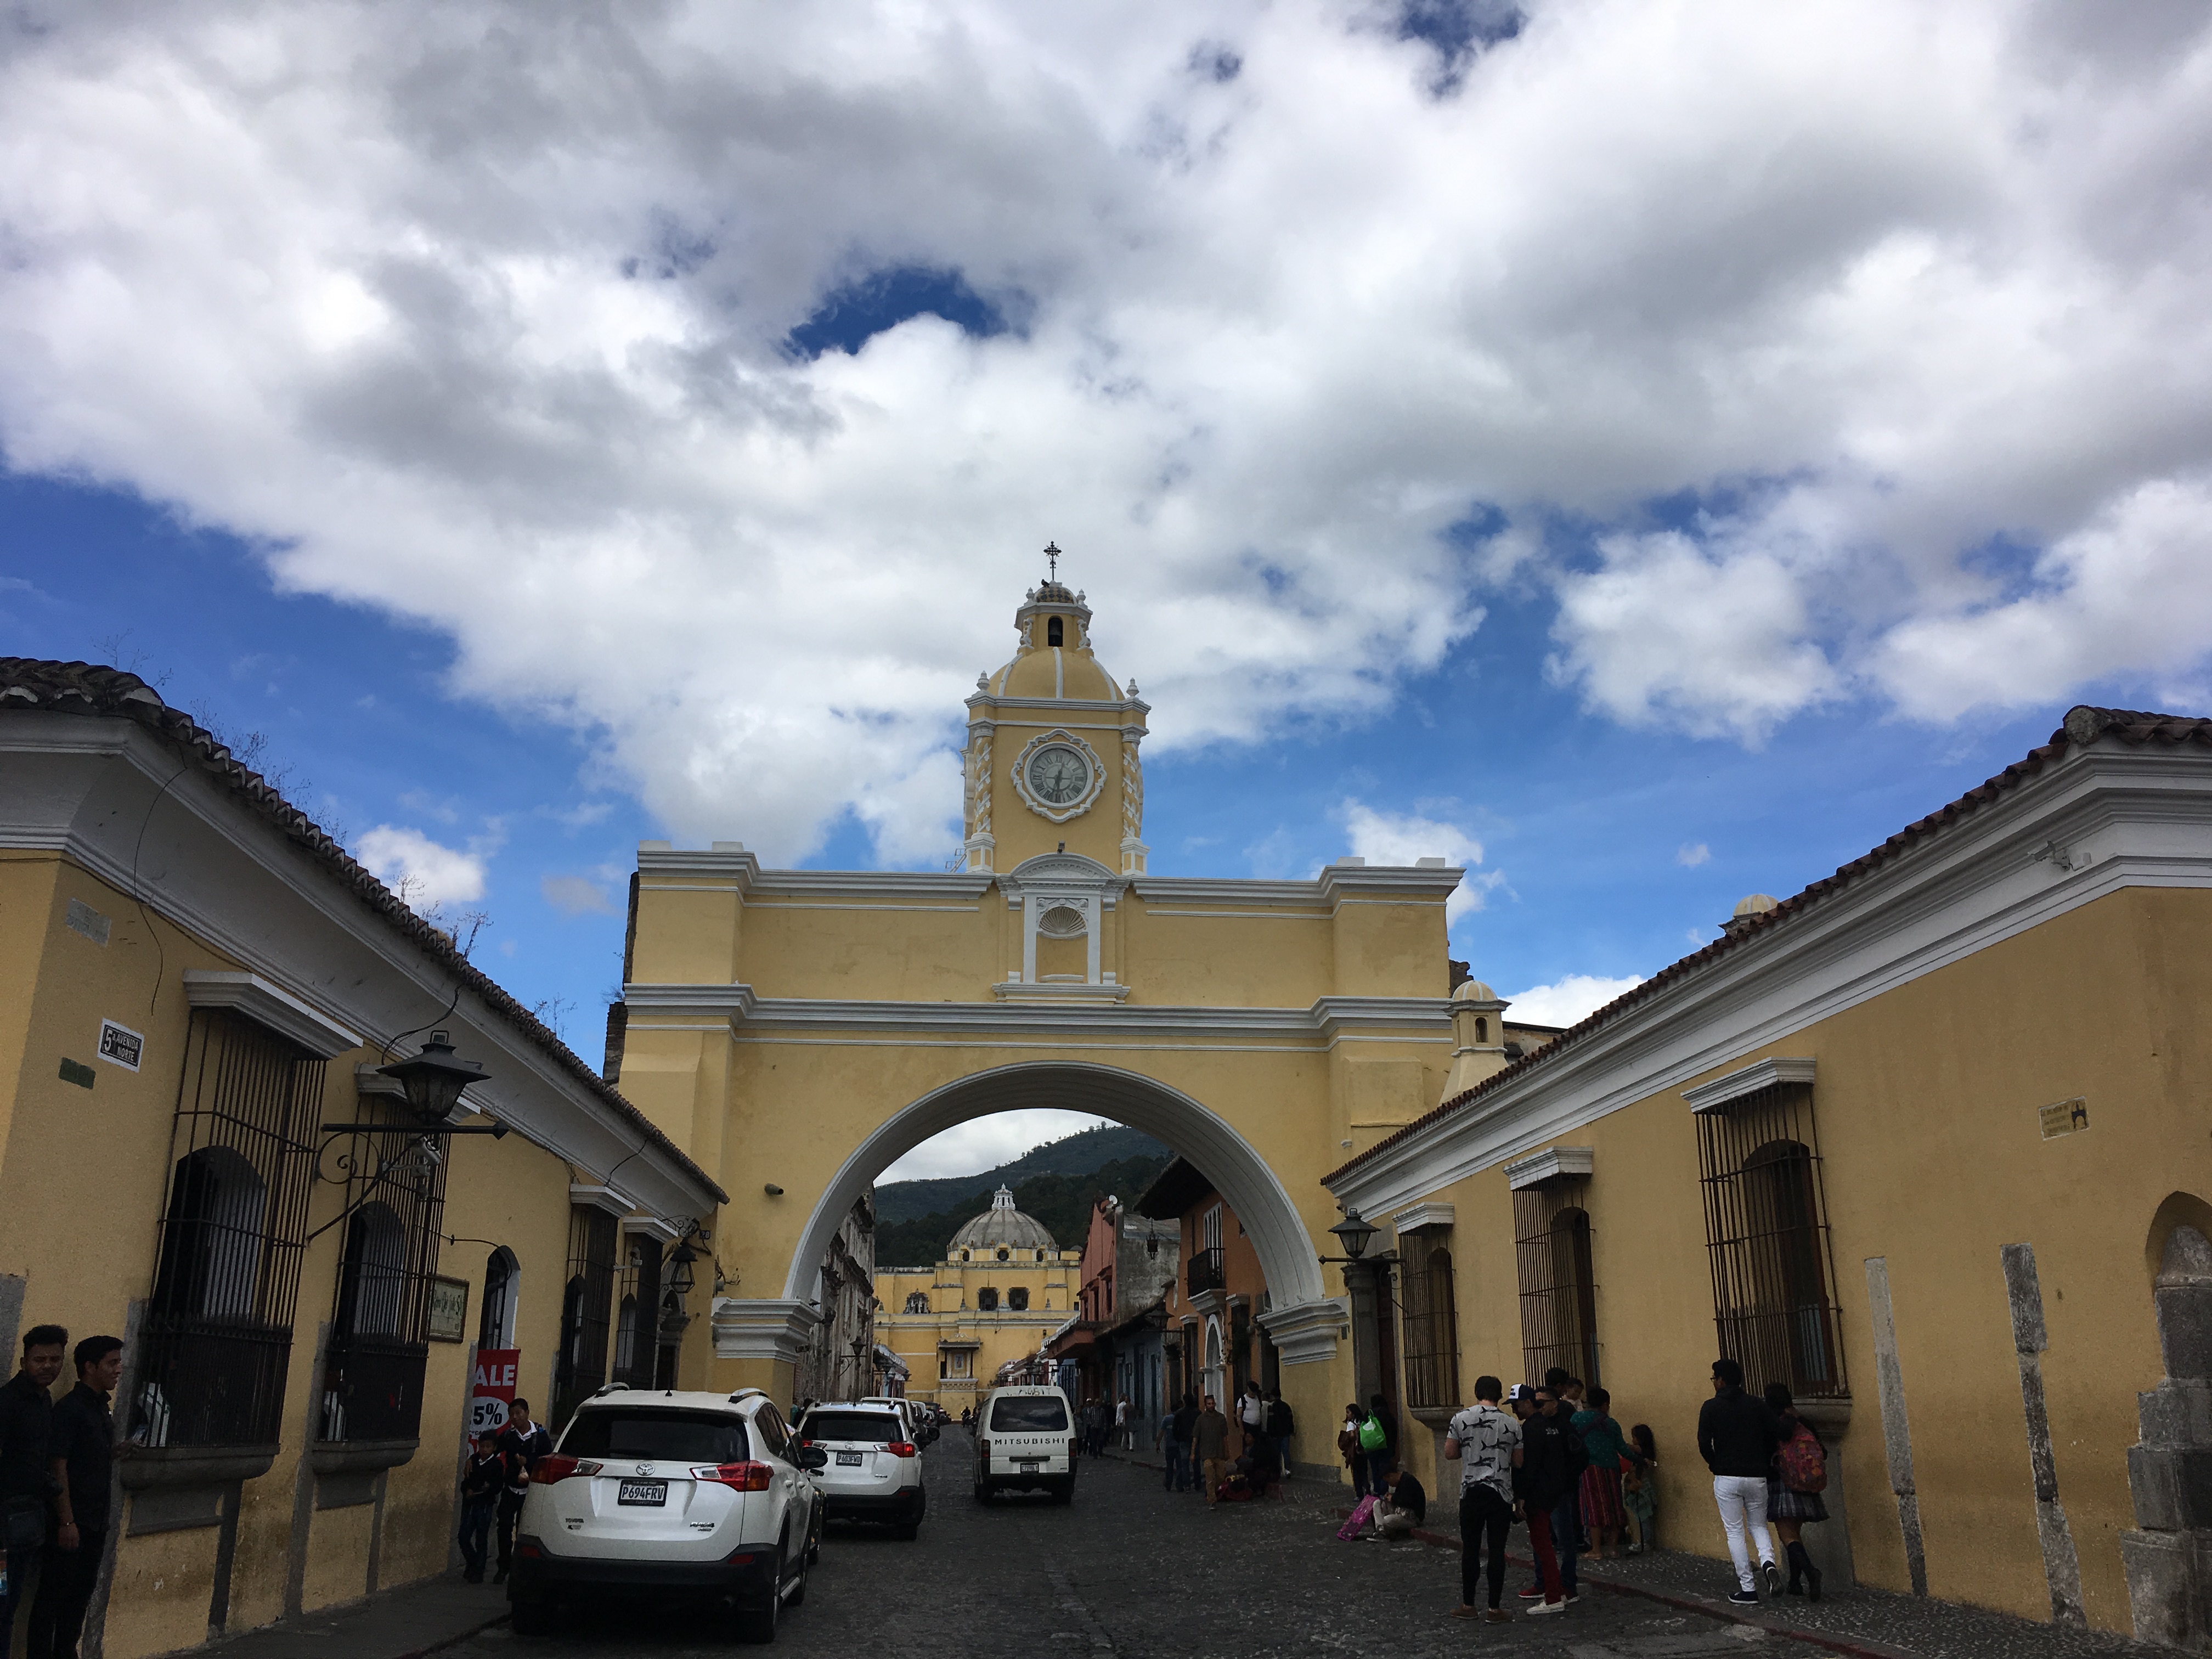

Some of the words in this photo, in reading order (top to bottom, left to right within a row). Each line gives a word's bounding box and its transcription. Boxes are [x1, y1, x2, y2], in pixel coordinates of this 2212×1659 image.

[116, 1034, 138, 1051] AVENIDA
[117, 1046, 134, 1061] NORTE
[622, 1486, 664, 1499] P694FRV
